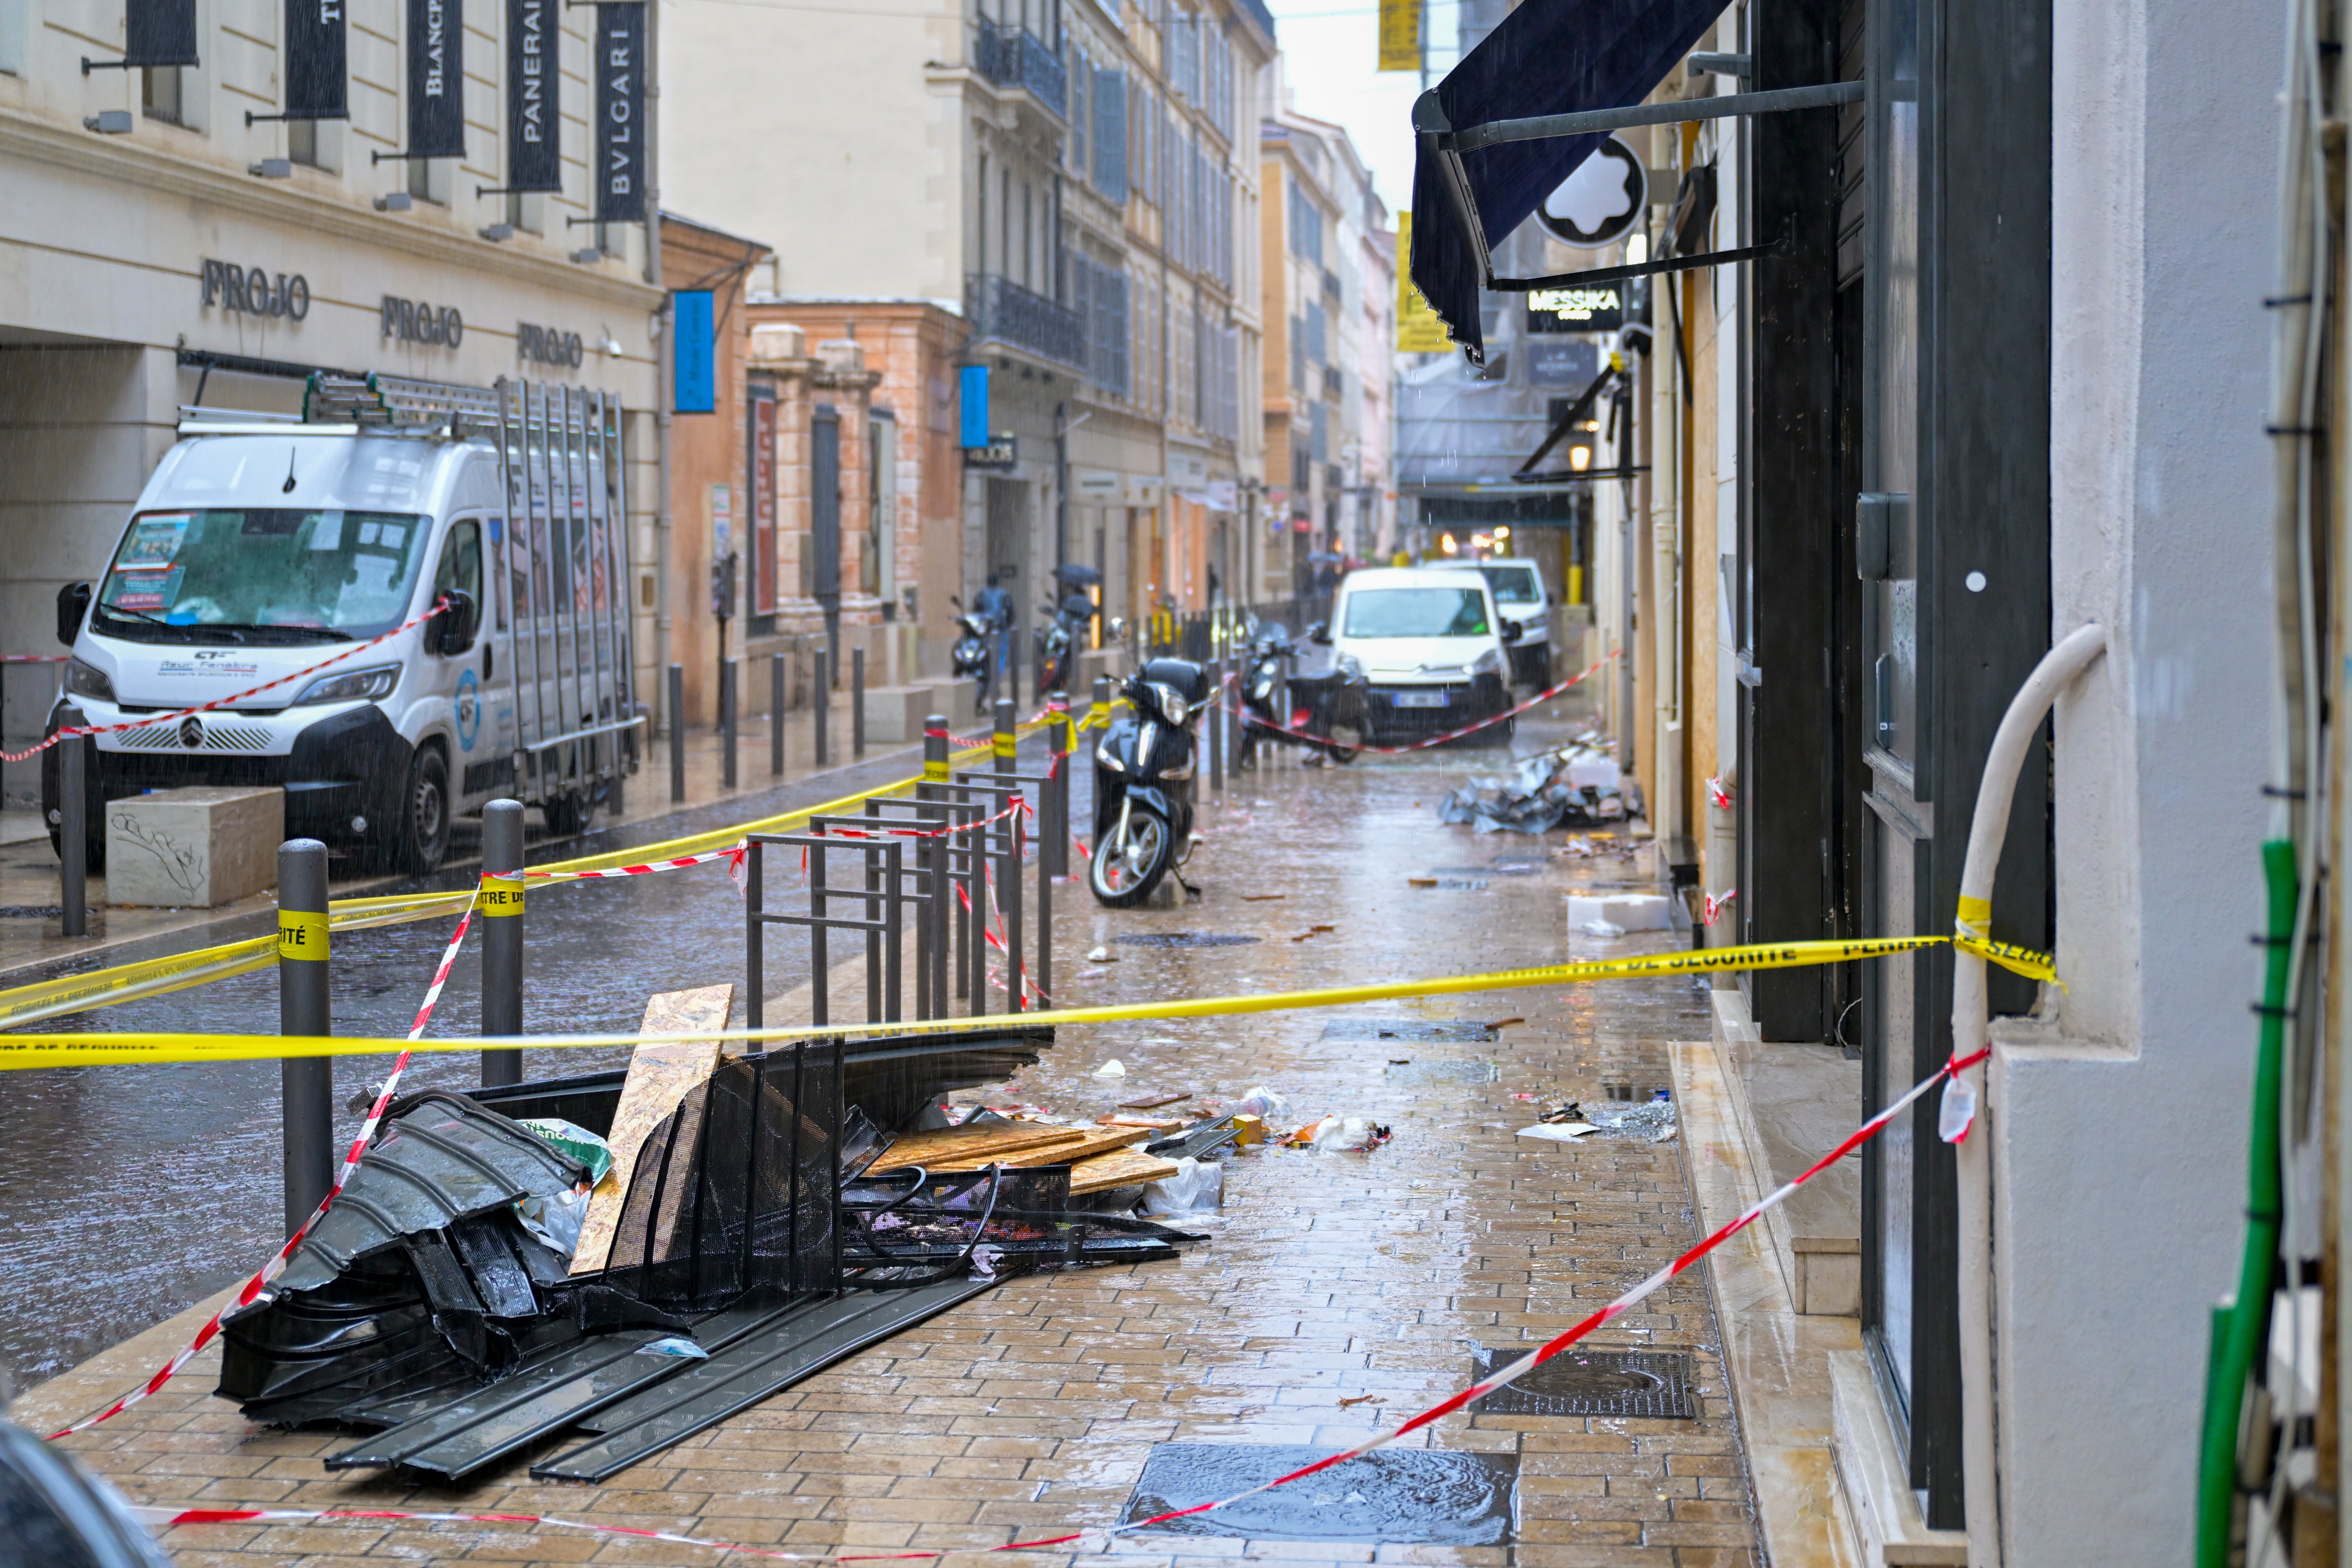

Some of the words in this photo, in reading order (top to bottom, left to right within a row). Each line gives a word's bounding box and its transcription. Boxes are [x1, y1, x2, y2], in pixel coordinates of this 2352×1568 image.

[523, 1, 547, 143] PANERAI
[610, 29, 630, 195] BVLGARI
[201, 258, 310, 322] FROJO
[1528, 289, 1621, 311] MESSIKA
[382, 296, 462, 350] FROJO
